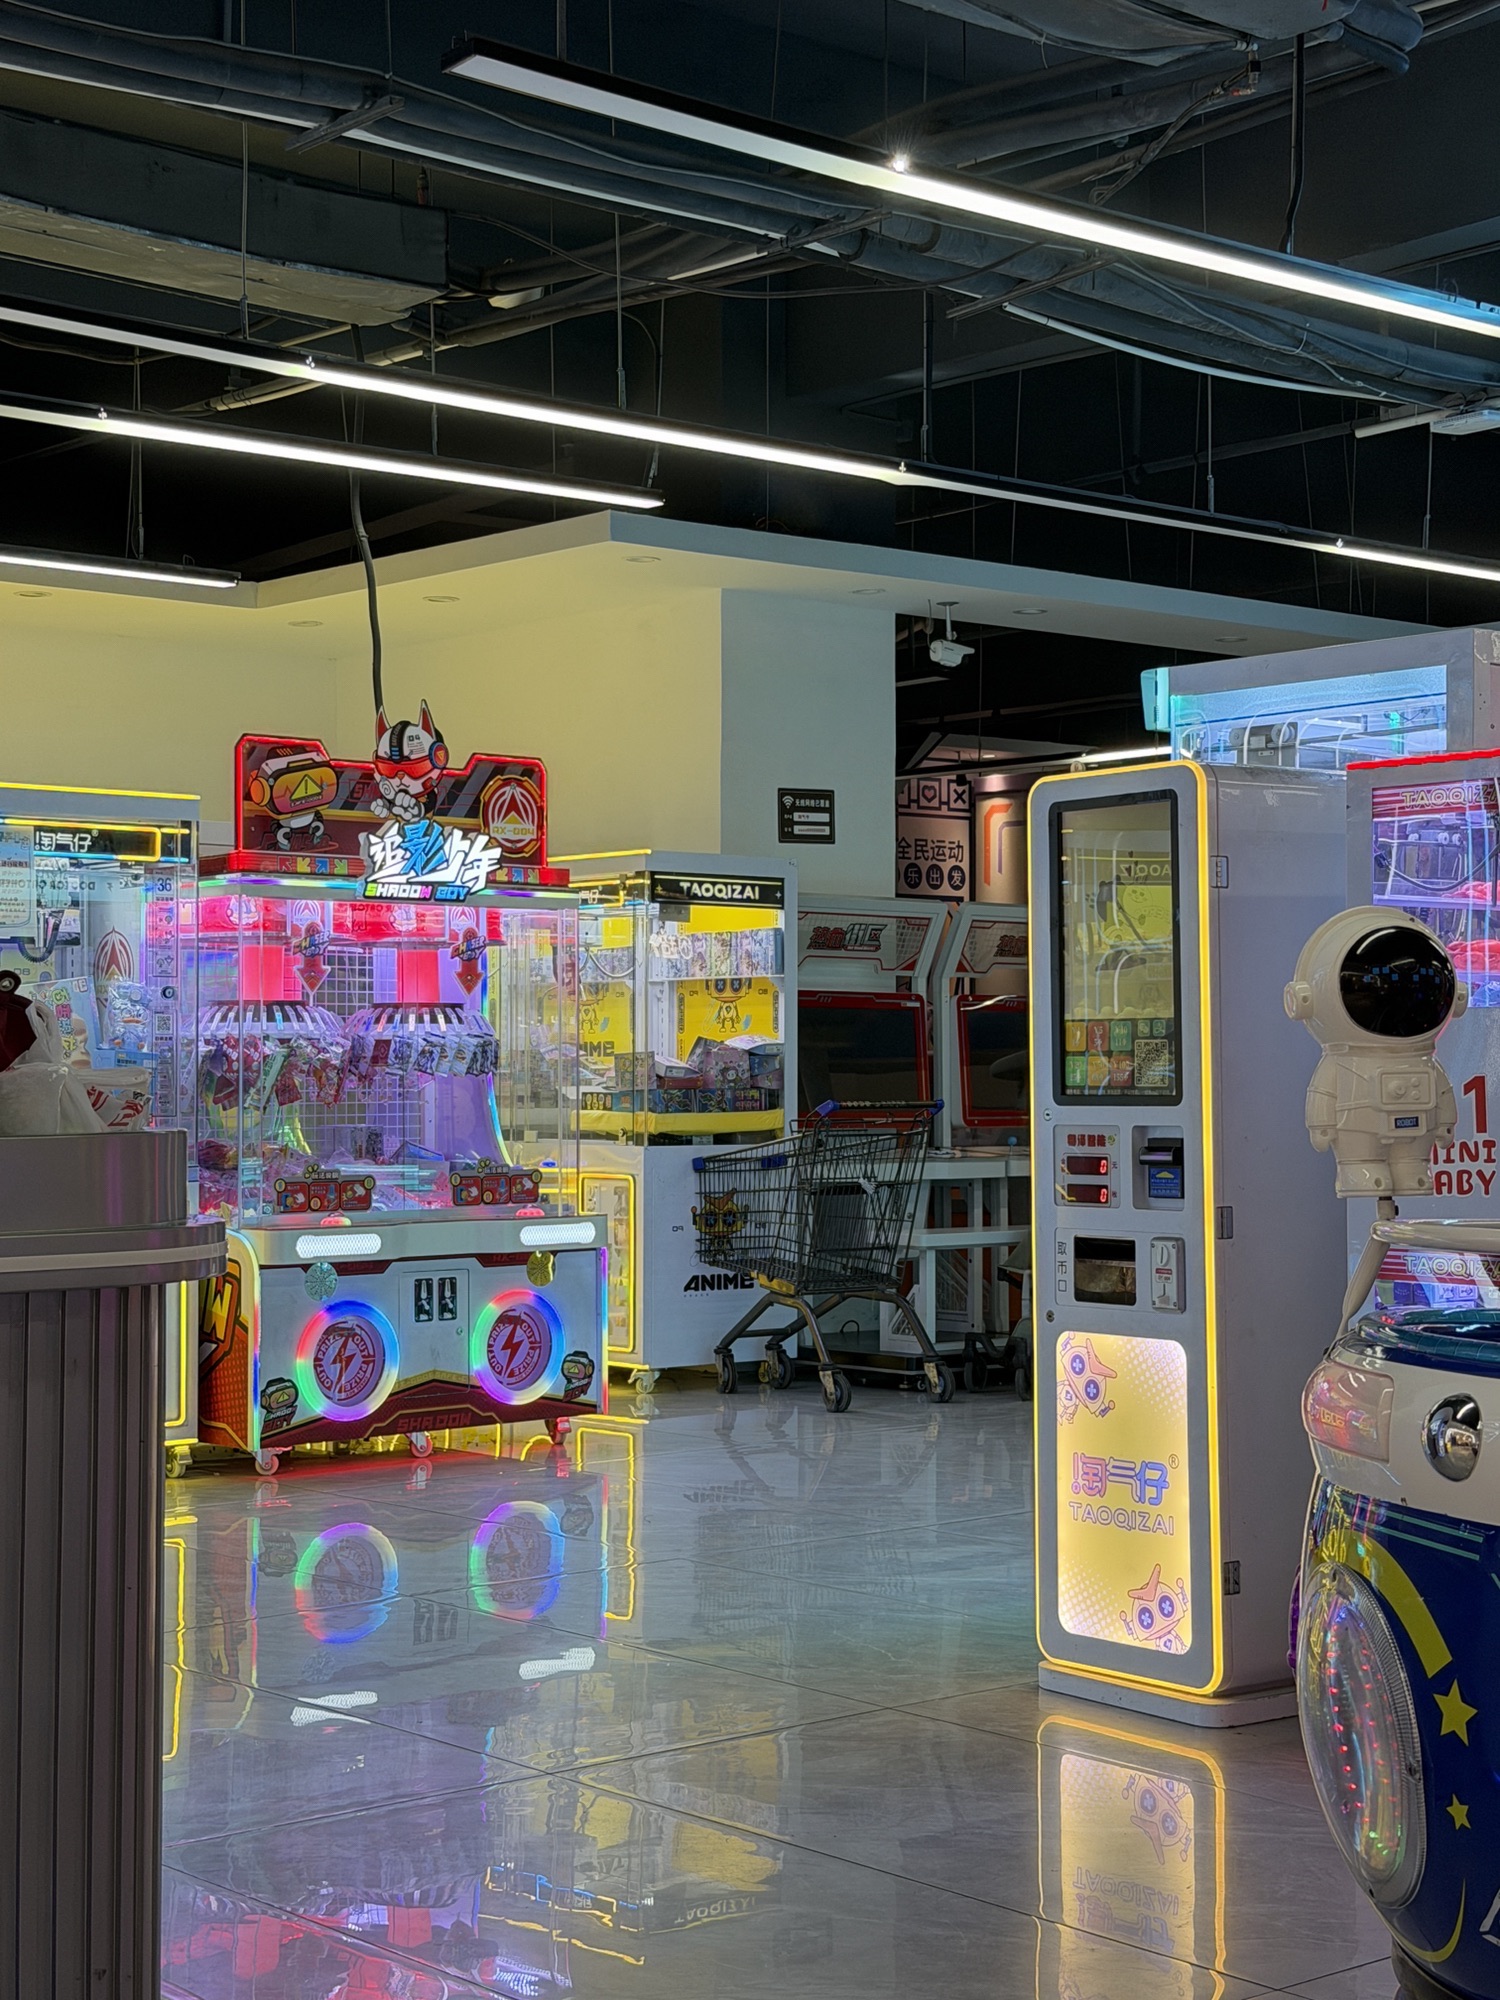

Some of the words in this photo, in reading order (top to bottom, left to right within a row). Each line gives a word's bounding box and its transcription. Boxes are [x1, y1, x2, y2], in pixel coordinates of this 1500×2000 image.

[896, 837, 965, 864] 全民运动
[157, 877, 173, 892] 36
[365, 883, 433, 899] SHADOW
[679, 881, 760, 900] TAOQIZAI
[1463, 1075, 1488, 1134] 1
[1395, 1118, 1418, 1127] ROBOT
[1100, 1159, 1108, 1174] 0
[1100, 1188, 1108, 1203] 0
[683, 1272, 755, 1293] ANIME
[396, 1412, 472, 1432] SHADOW
[1068, 1501, 1175, 1536] TAOQIZAI
